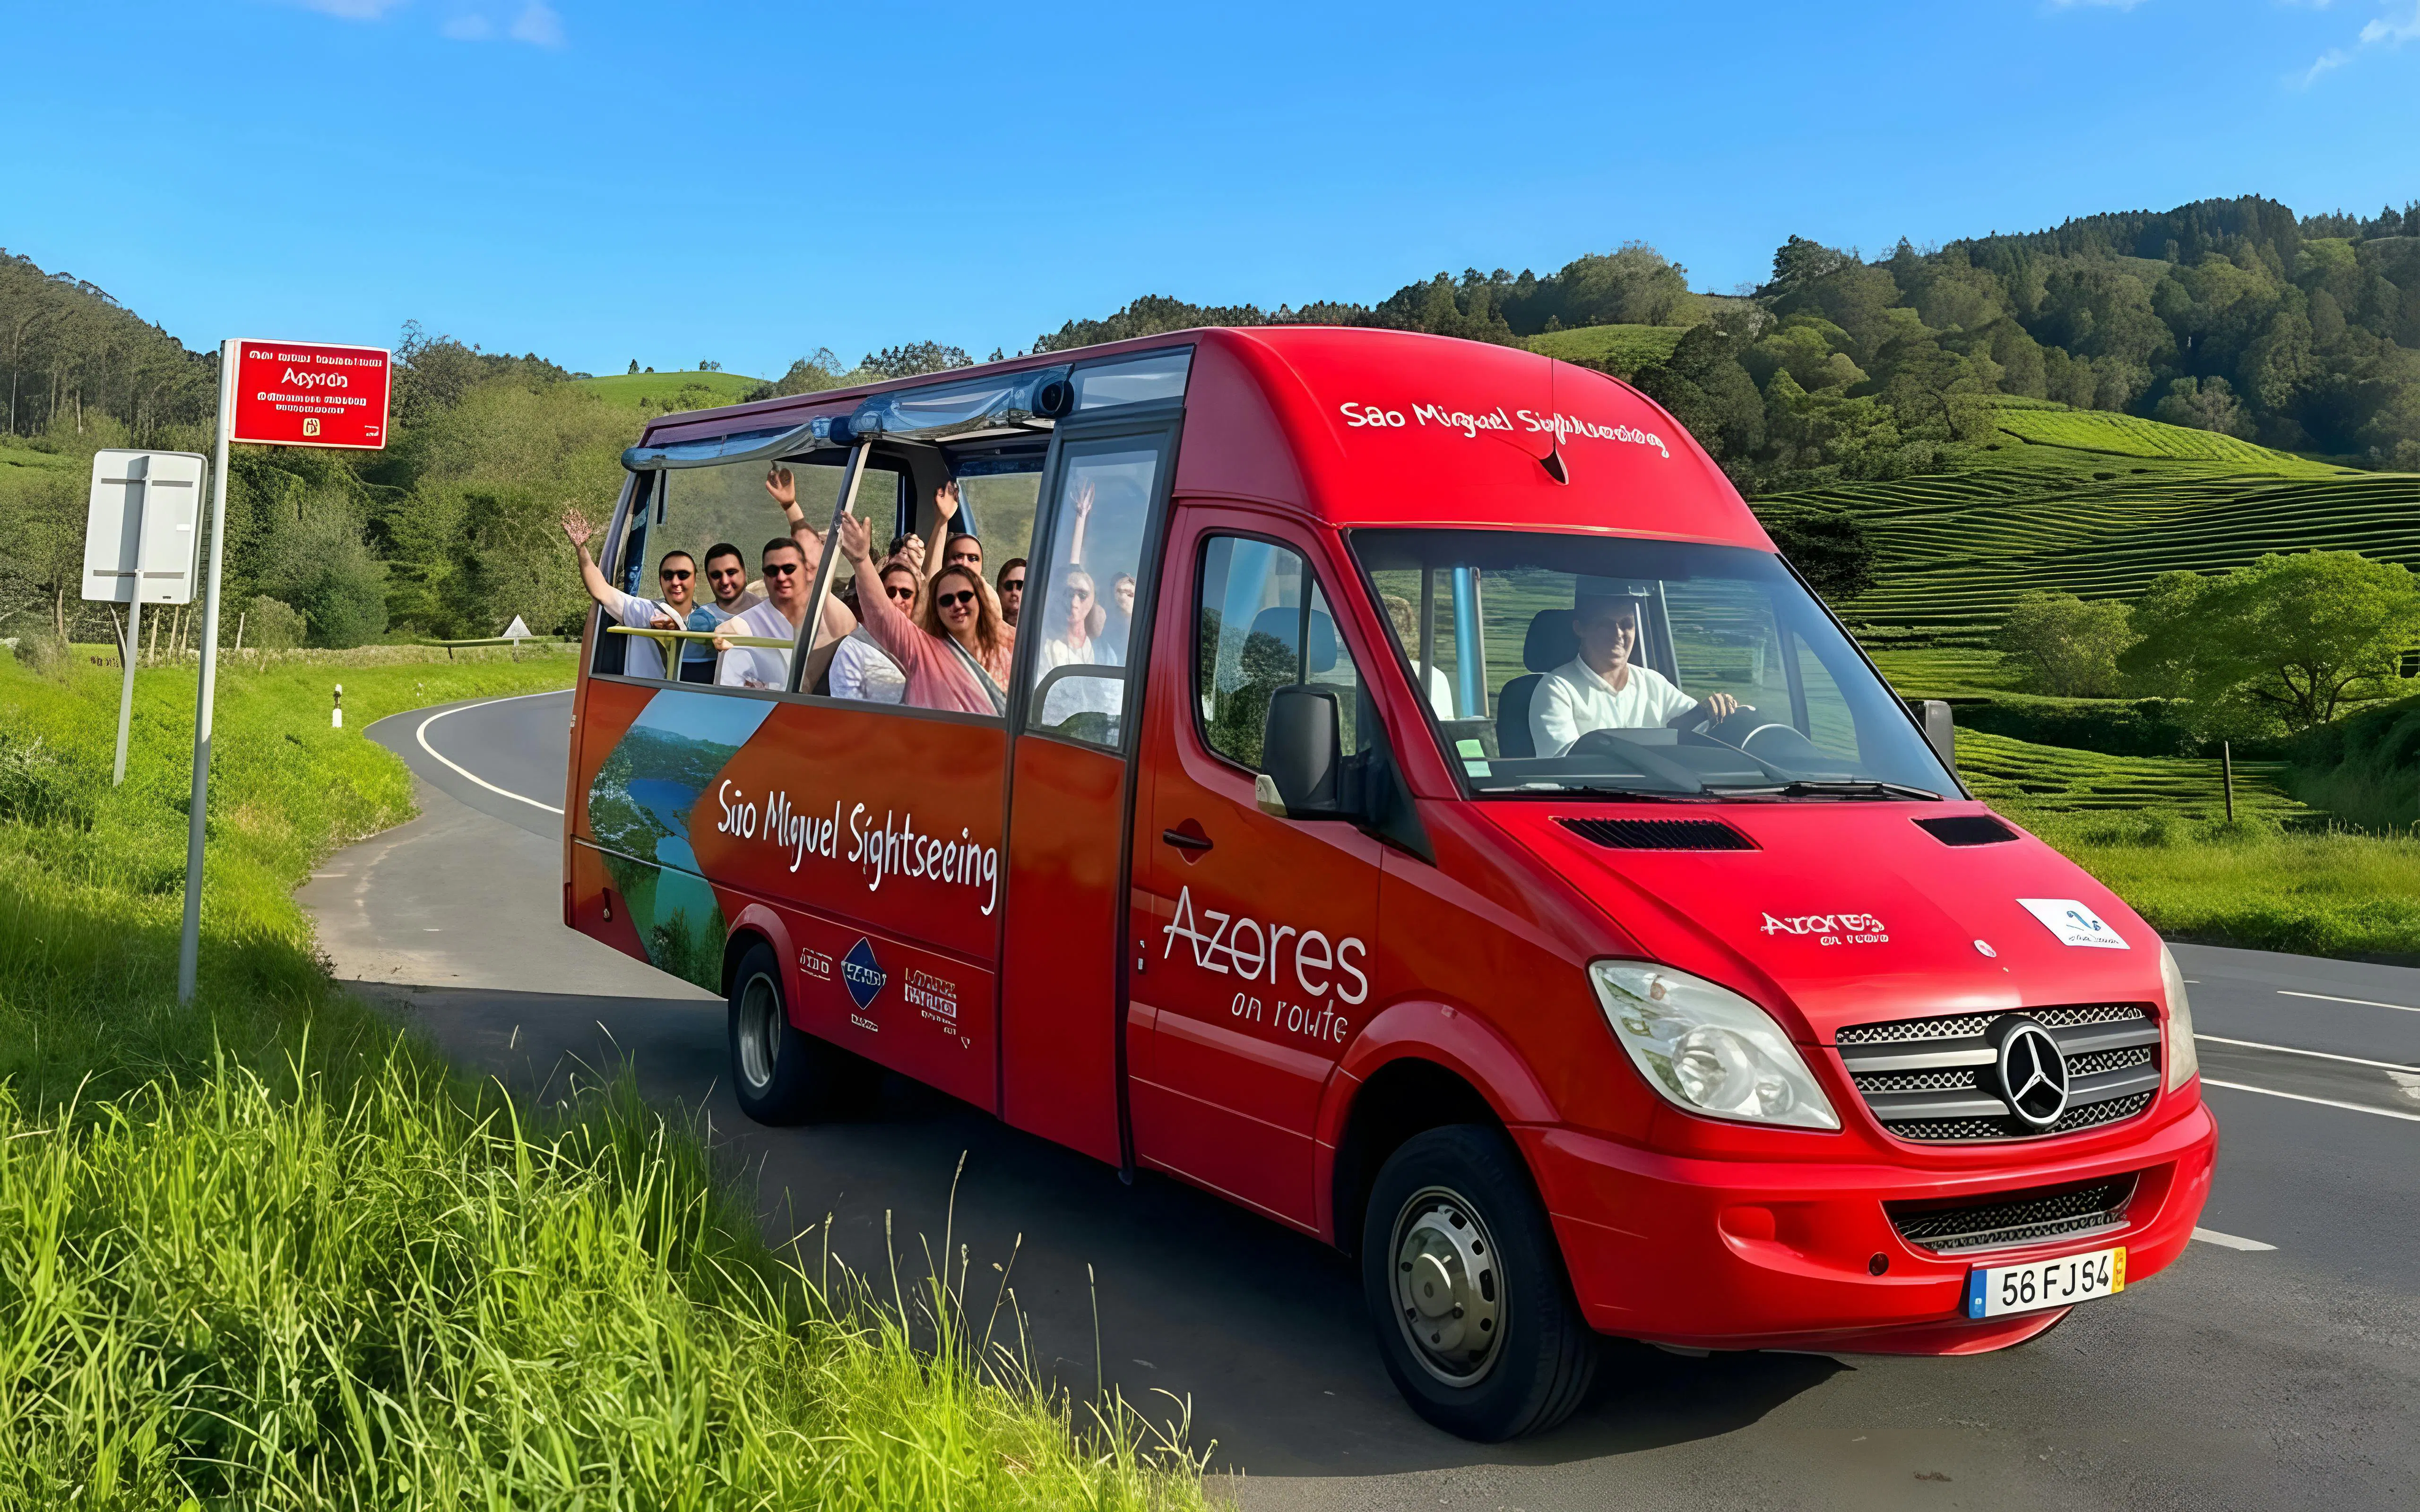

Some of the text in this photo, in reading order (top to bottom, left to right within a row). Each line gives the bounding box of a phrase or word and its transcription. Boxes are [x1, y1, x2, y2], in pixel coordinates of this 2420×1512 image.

[848, 802, 997, 916] Sightseeing
[1163, 885, 1368, 1005] Azores
[1232, 992, 1348, 1043] on route
[2002, 1270, 2035, 1306] 56
